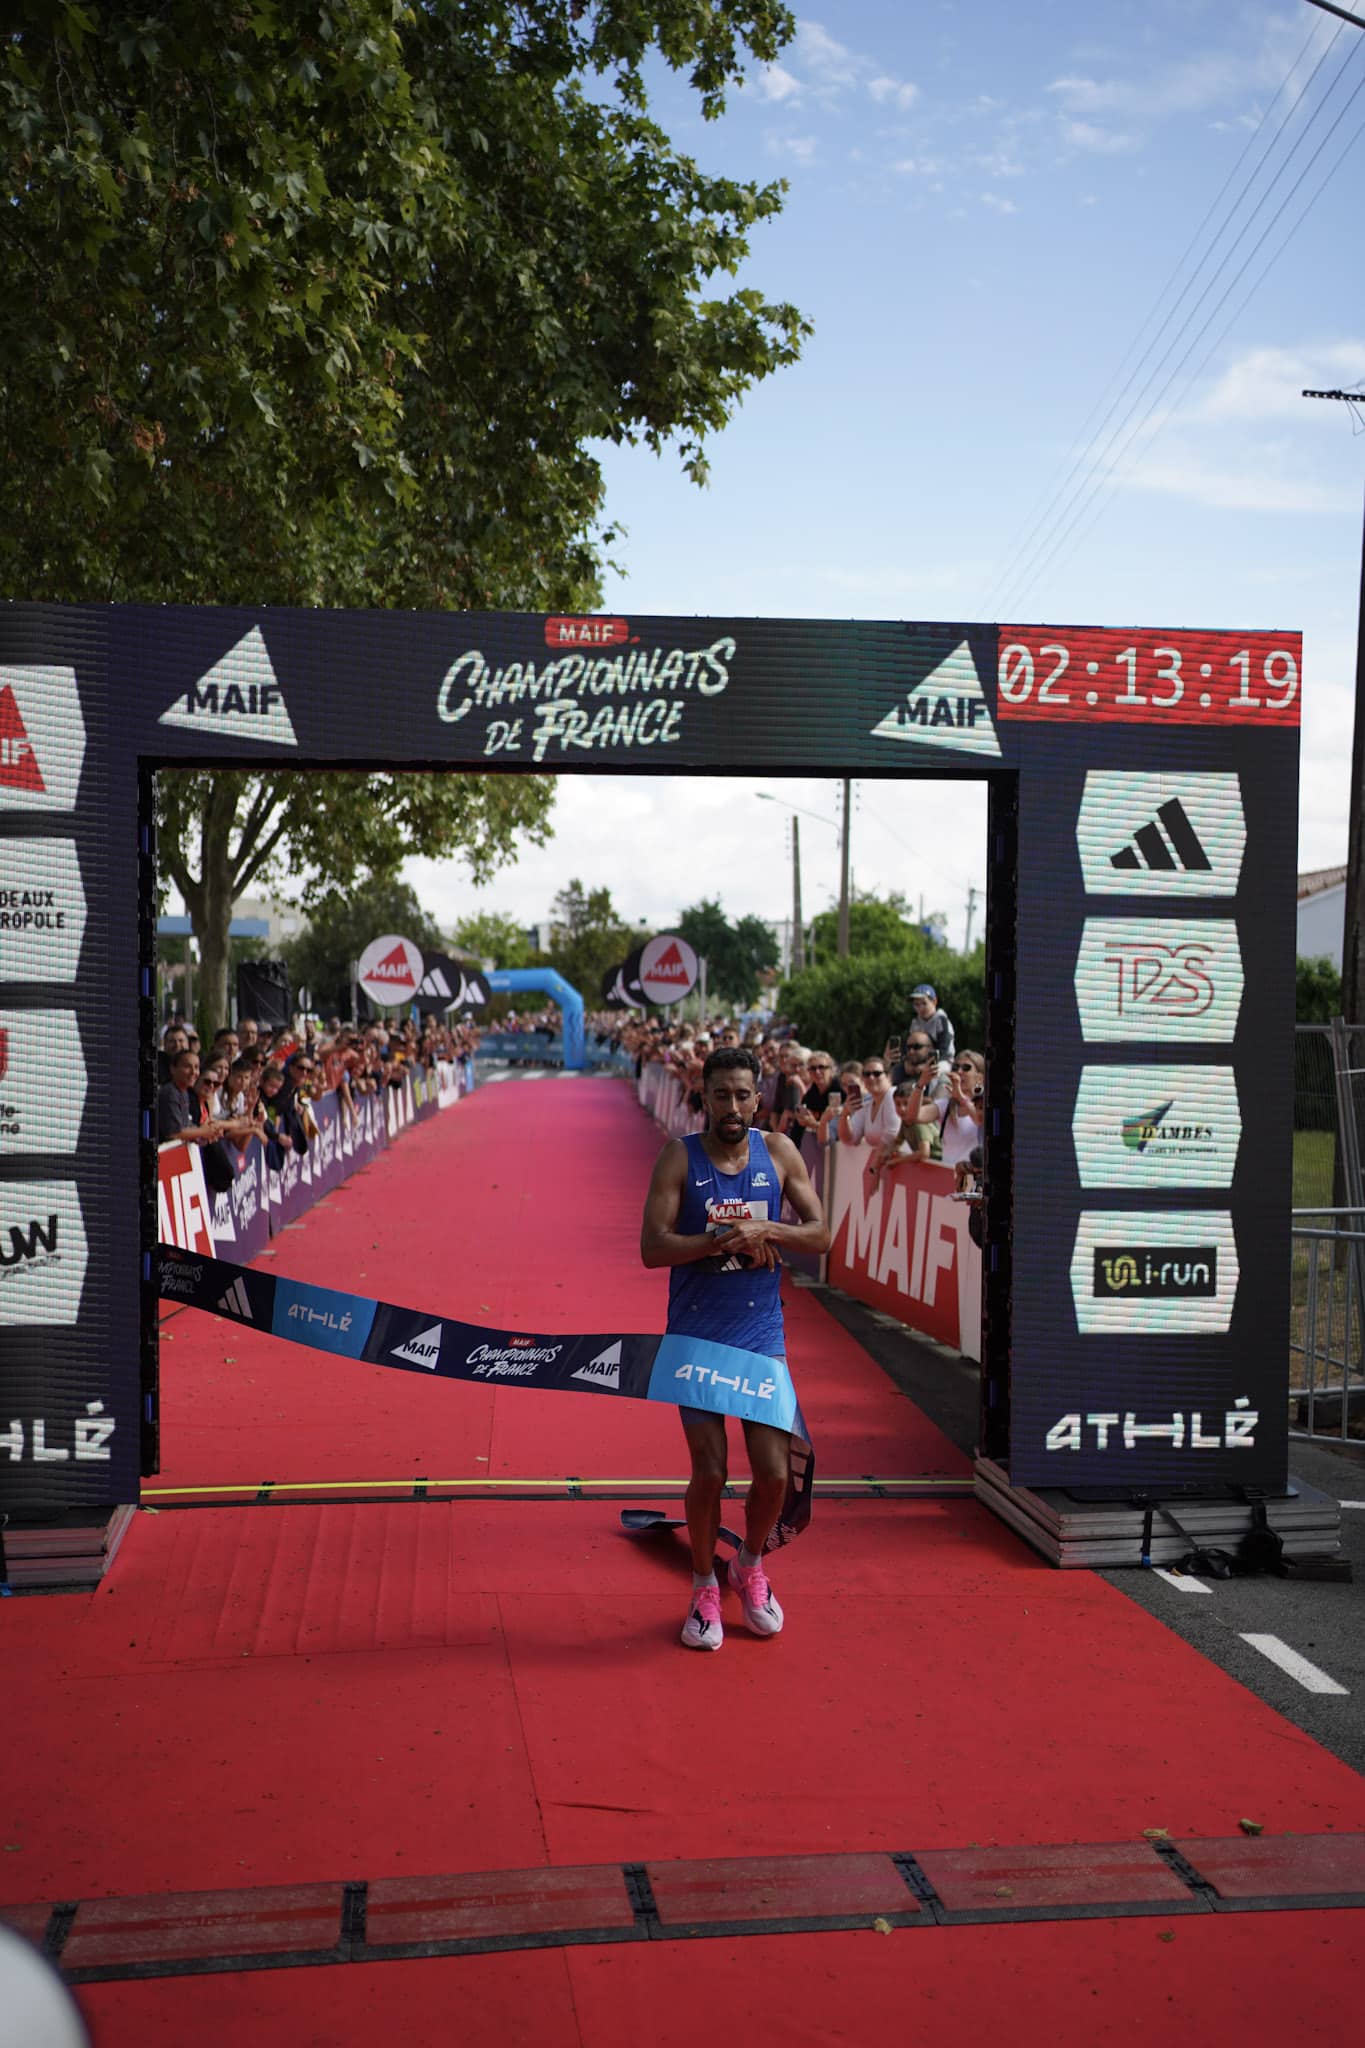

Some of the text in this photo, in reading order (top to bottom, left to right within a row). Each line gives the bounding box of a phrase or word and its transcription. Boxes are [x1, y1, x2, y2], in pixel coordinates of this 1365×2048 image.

[559, 623, 614, 642] MAIF
[437, 636, 737, 723] CHAMPIONNATS
[998, 643, 1298, 709] 02:13:19
[186, 683, 281, 715] MAIF
[897, 697, 985, 727] MAIF
[483, 699, 685, 762] DE FRANCE
[712, 1205, 751, 1218] MAIF
[845, 1178, 957, 1307] MAIF
[288, 1303, 353, 1332] ATHLÉ
[402, 1341, 440, 1359] MAIF
[466, 1343, 563, 1365] CHAMPIONNATS
[472, 1361, 540, 1378] DE FRANCE
[582, 1362, 621, 1377] MAIF
[674, 1363, 777, 1400] ATHLÉ
[1046, 1395, 1259, 1451] ATHLÉ
